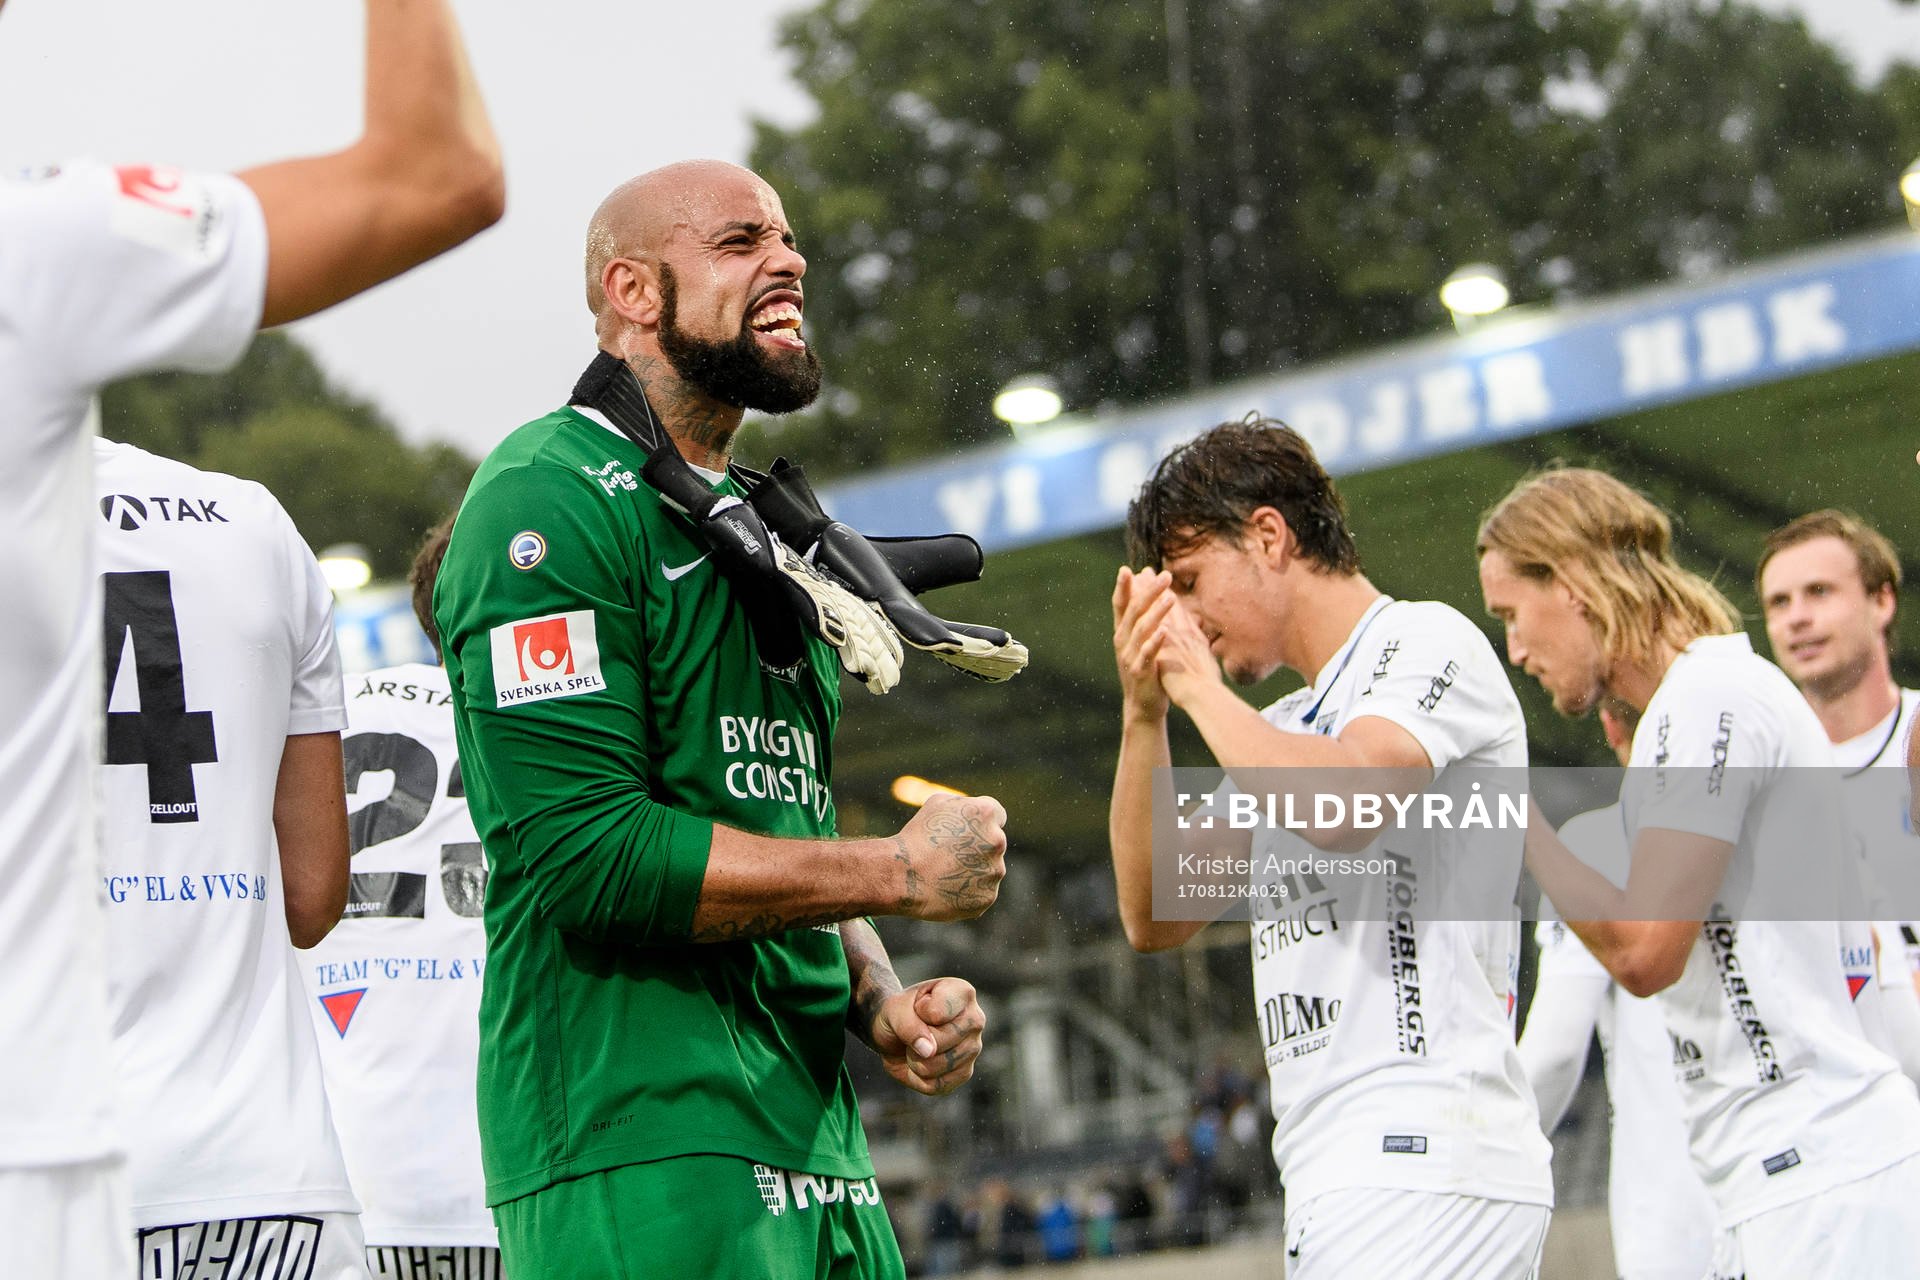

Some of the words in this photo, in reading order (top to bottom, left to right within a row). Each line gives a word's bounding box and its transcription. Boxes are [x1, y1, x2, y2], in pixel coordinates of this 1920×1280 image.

[1621, 282, 1847, 396] HBK
[150, 497, 229, 522] TAK
[103, 570, 218, 823] 4
[500, 682, 563, 702] SVENSKA
[567, 676, 601, 690] SPEL
[150, 802, 197, 815] ZELLOUT
[145, 876, 174, 901] EL
[180, 875, 197, 901] &
[202, 873, 248, 900] VVS
[344, 902, 381, 913] ELLOUT
[1254, 899, 1339, 961] STRUCT
[316, 959, 368, 986] TEAM
[416, 959, 443, 980] EL
[449, 959, 464, 980] &
[592, 1114, 634, 1132] DRI-FIT
